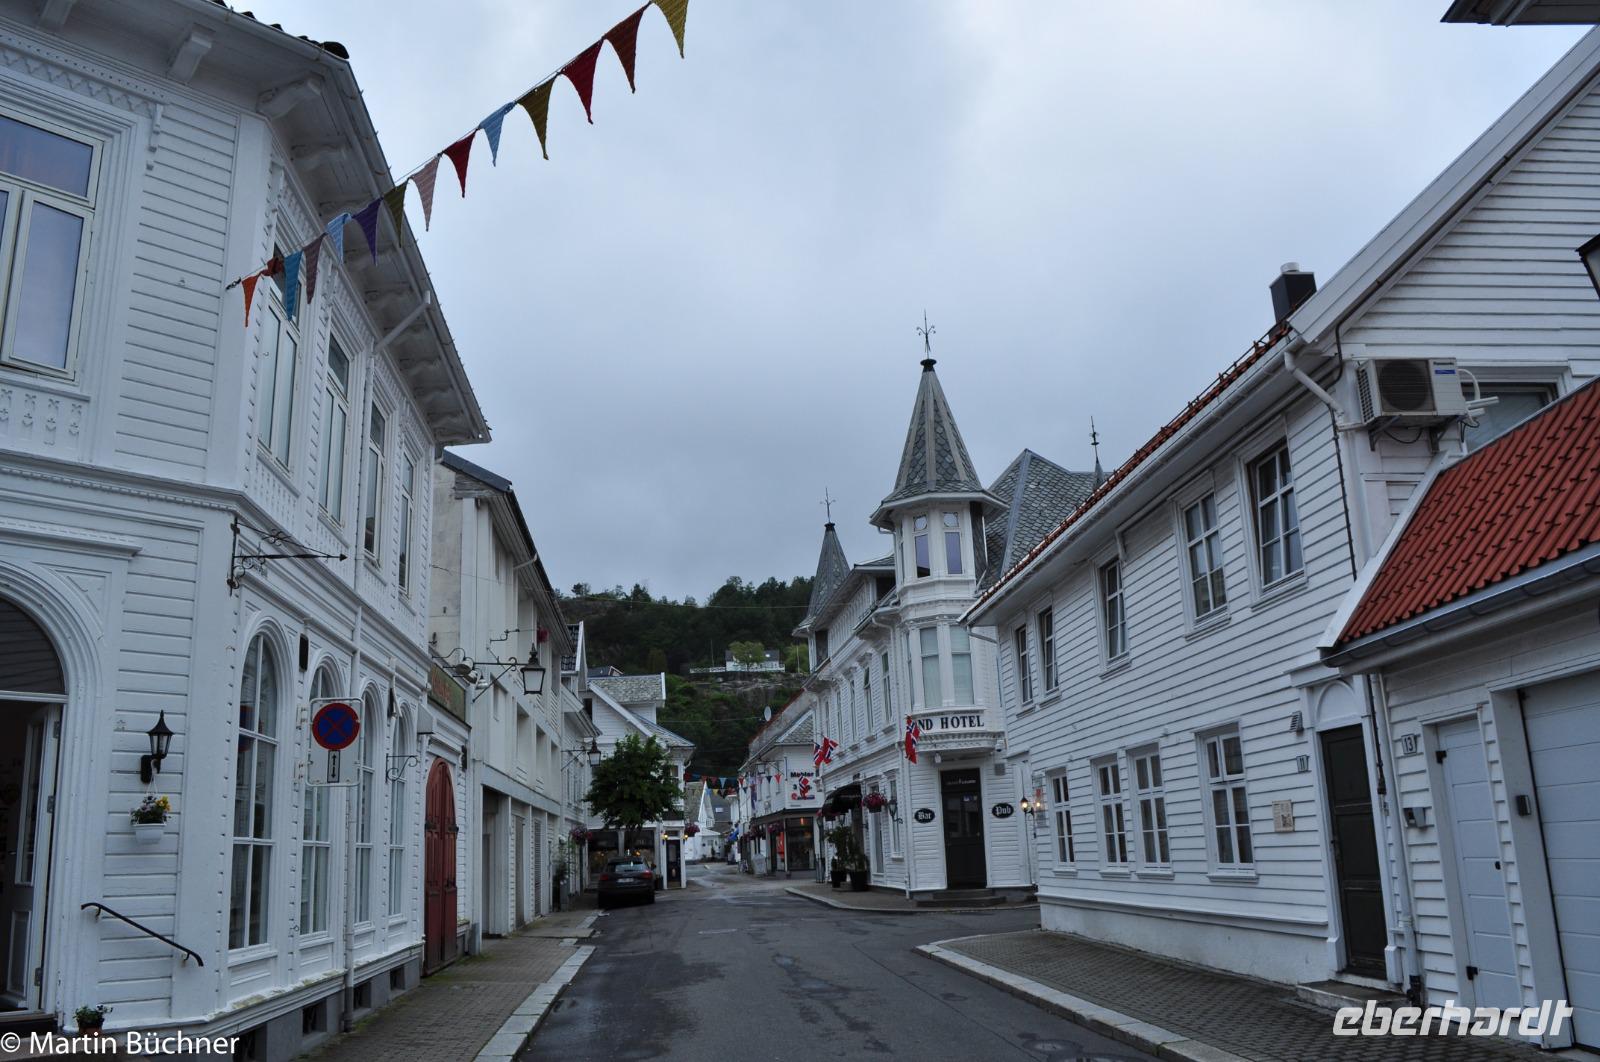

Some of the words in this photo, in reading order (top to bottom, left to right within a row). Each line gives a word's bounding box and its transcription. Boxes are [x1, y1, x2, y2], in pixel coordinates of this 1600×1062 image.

[940, 715, 985, 729] HOTEL
[1404, 736, 1414, 752] 13
[917, 811, 932, 820] Bar
[995, 806, 1012, 816] Pub
